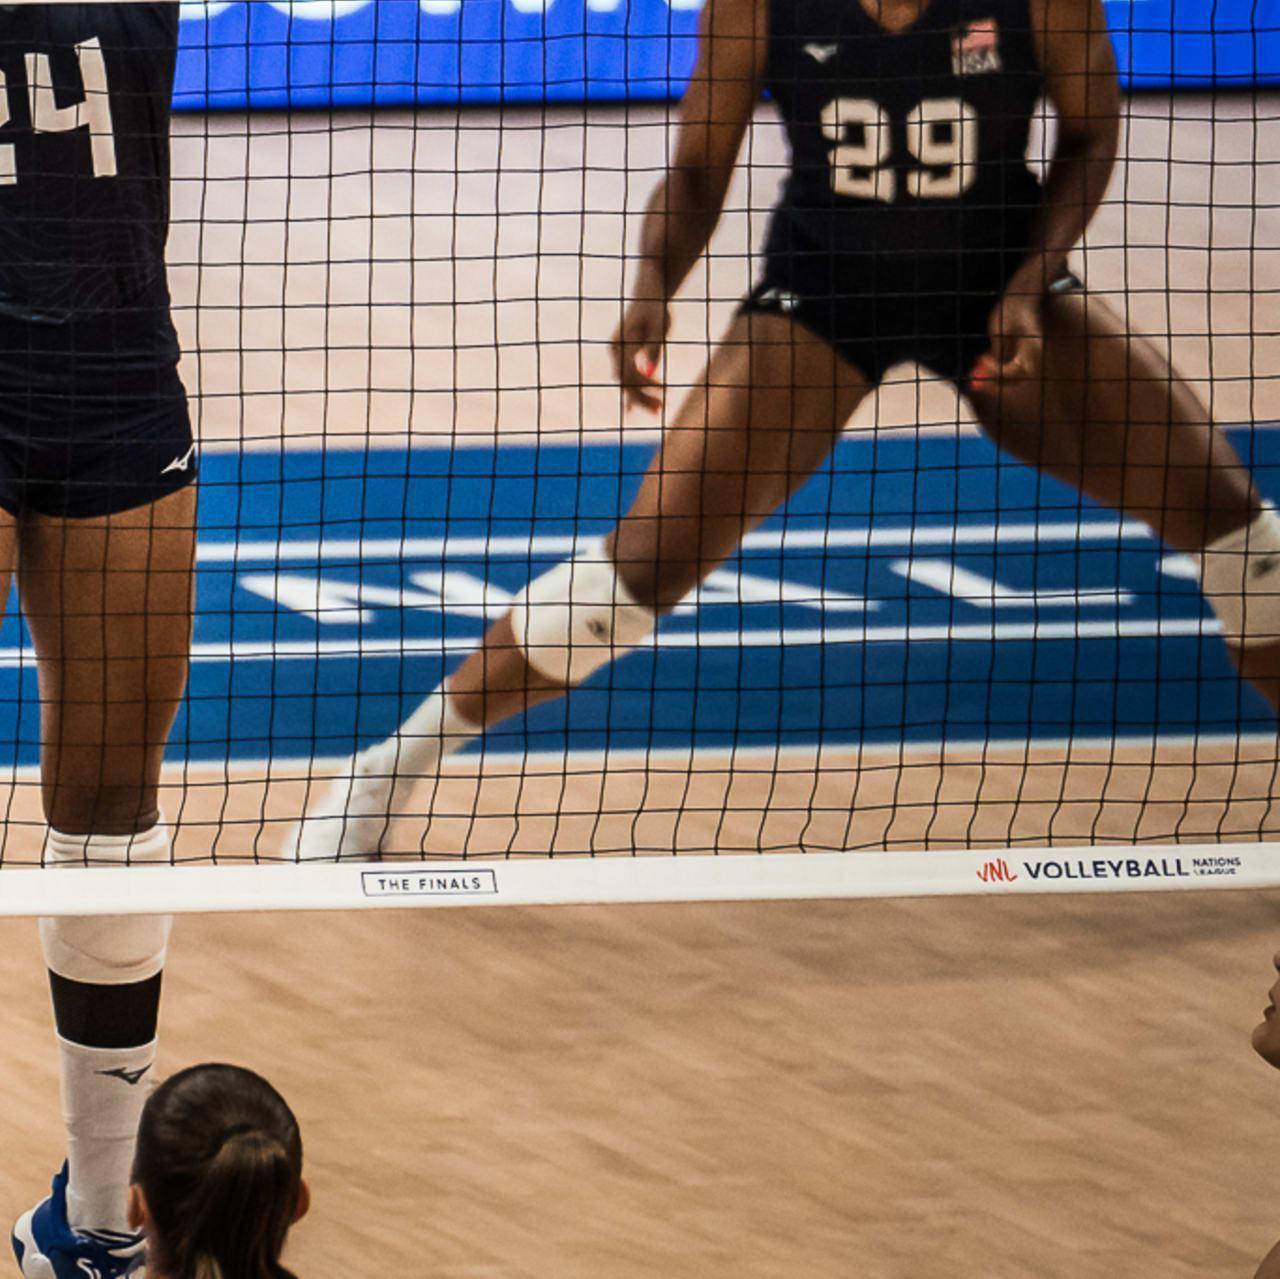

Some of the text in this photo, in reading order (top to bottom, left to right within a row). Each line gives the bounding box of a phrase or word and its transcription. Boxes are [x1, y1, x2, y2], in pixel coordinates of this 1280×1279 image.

[819, 96, 979, 204] 29
[975, 857, 1190, 883] VNL VOLLEYBALL
[1192, 856, 1242, 867] NATIONS
[378, 877, 482, 891] THE FINALS
